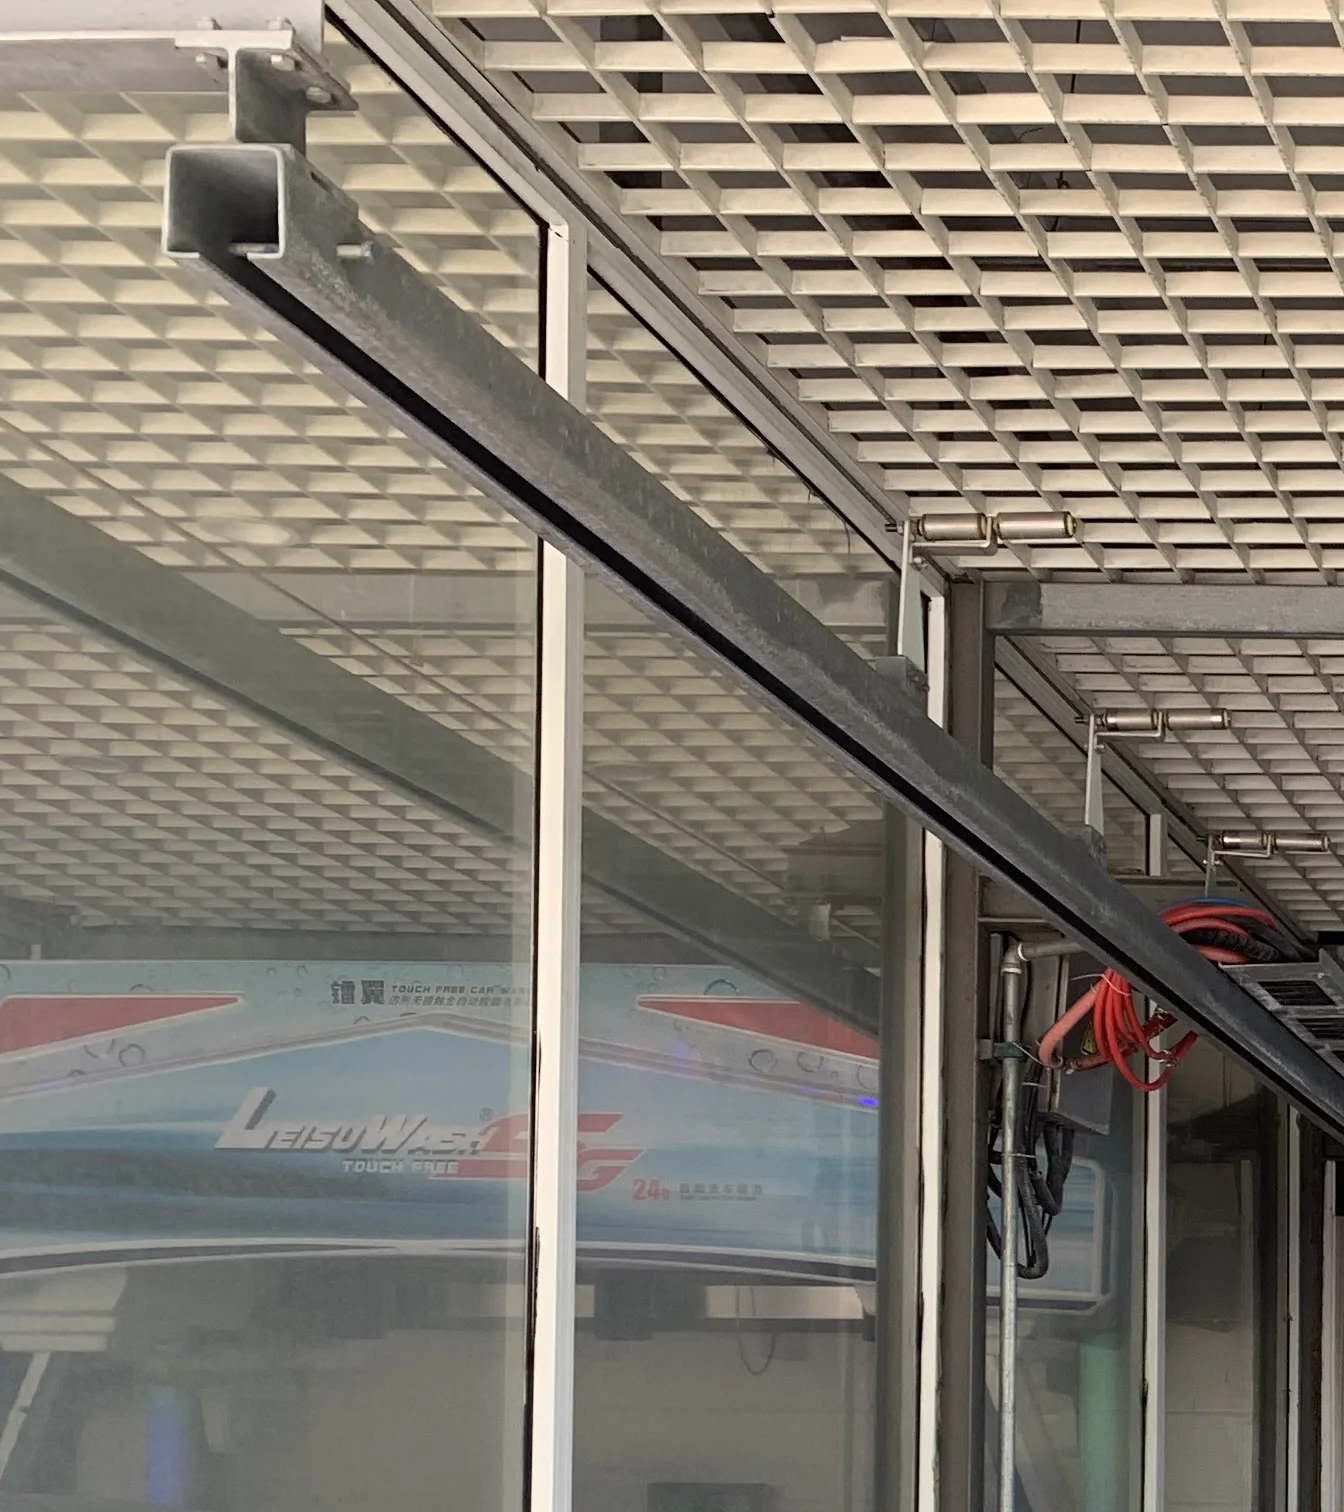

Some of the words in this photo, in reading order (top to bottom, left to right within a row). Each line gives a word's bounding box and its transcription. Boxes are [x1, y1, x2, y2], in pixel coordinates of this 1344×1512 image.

[391, 985, 431, 994] TOUCH
[435, 985, 466, 994] FREE
[342, 1158, 403, 1174] TOUCH
[411, 1158, 460, 1174] FREE
